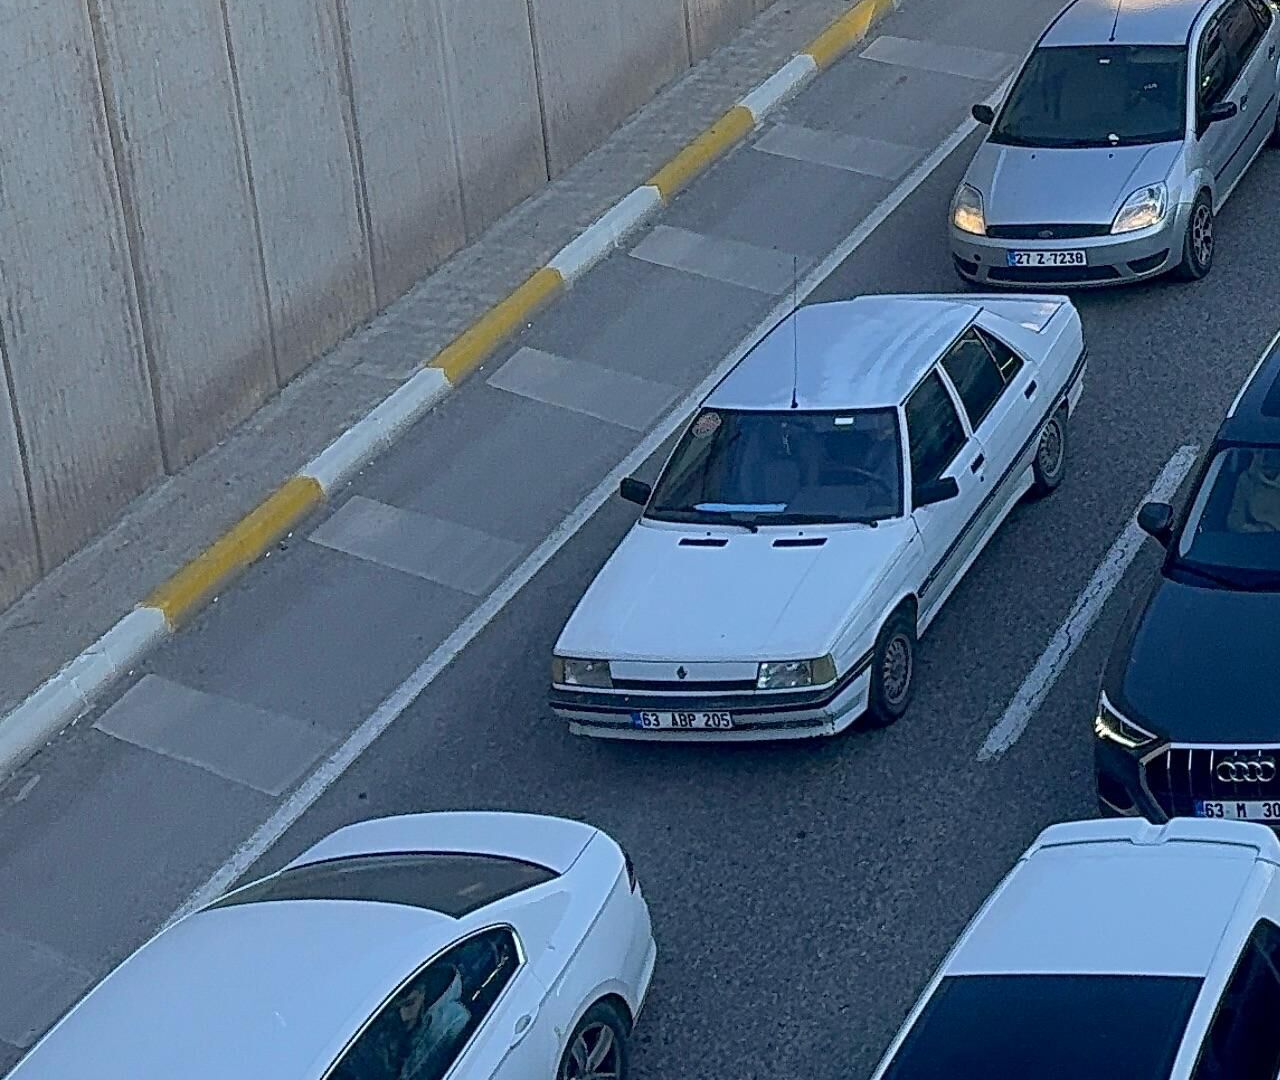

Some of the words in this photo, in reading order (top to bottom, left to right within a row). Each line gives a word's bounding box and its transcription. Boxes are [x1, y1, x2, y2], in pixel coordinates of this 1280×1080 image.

[1016, 253, 1031, 265] 27
[642, 712, 660, 728] 63
[671, 712, 697, 728] ABP
[703, 712, 730, 728] 205
[1205, 802, 1224, 819] 63
[1236, 802, 1247, 818] M
